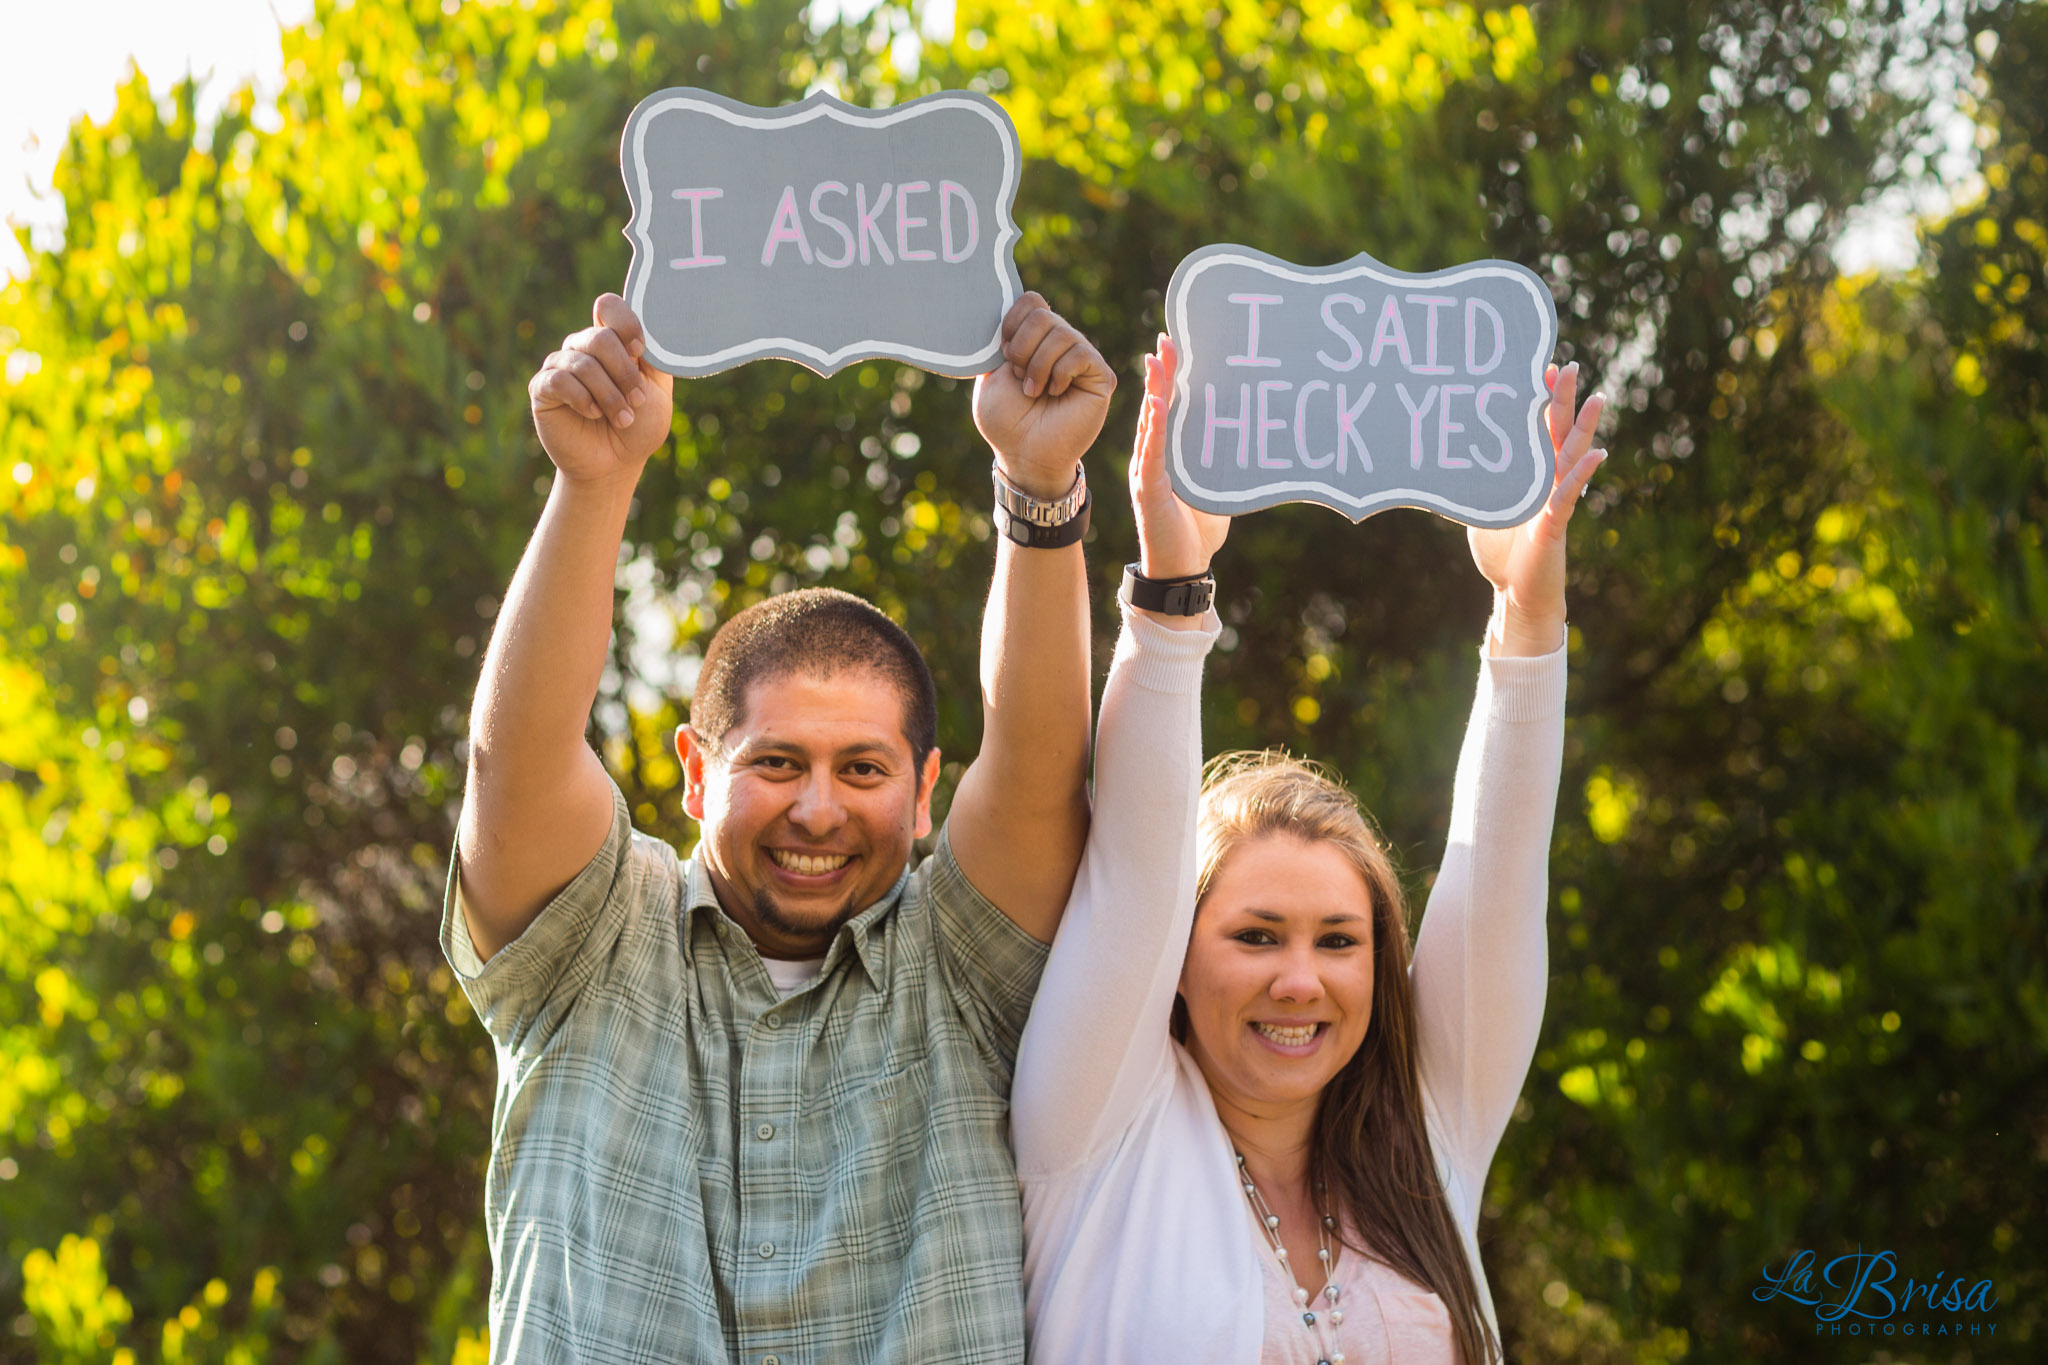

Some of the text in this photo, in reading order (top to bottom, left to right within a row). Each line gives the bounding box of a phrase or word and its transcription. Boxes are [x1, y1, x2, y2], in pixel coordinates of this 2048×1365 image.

[670, 181, 979, 269] I ASKED
[1225, 293, 1506, 375] I SAID
[1200, 380, 1517, 474] HECK YES
